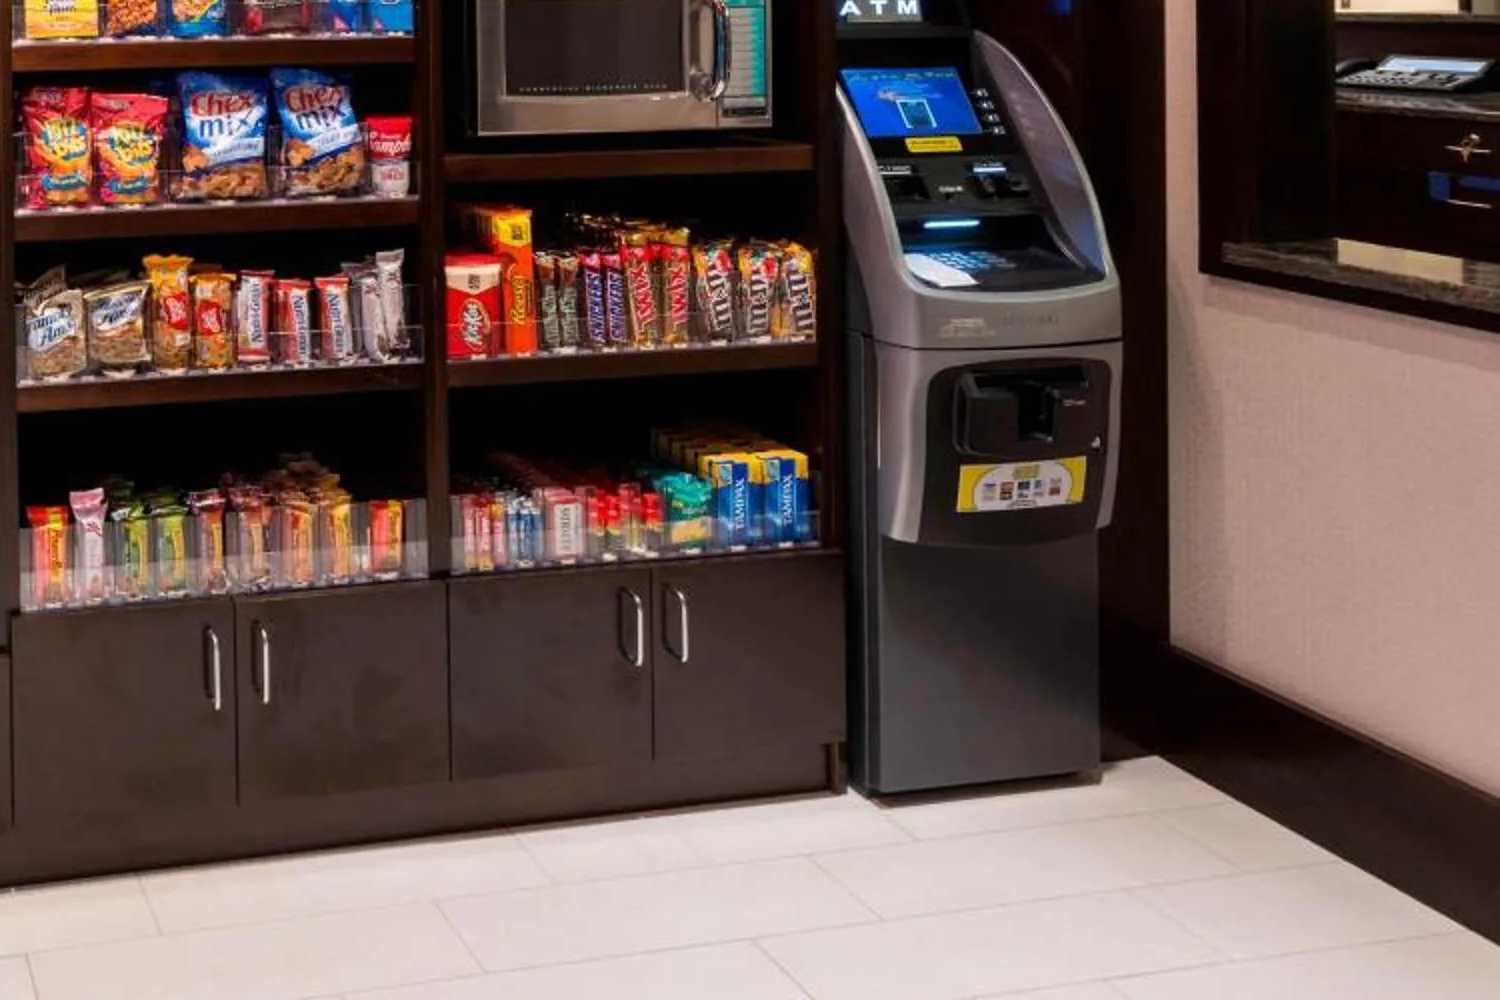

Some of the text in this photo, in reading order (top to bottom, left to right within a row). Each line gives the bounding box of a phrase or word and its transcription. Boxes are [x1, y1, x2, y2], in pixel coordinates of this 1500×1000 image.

[839, 0, 918, 17] ATM
[191, 91, 254, 117] Chex
[736, 477, 746, 530] TAMPAX
[782, 472, 793, 525] TAMPAX
